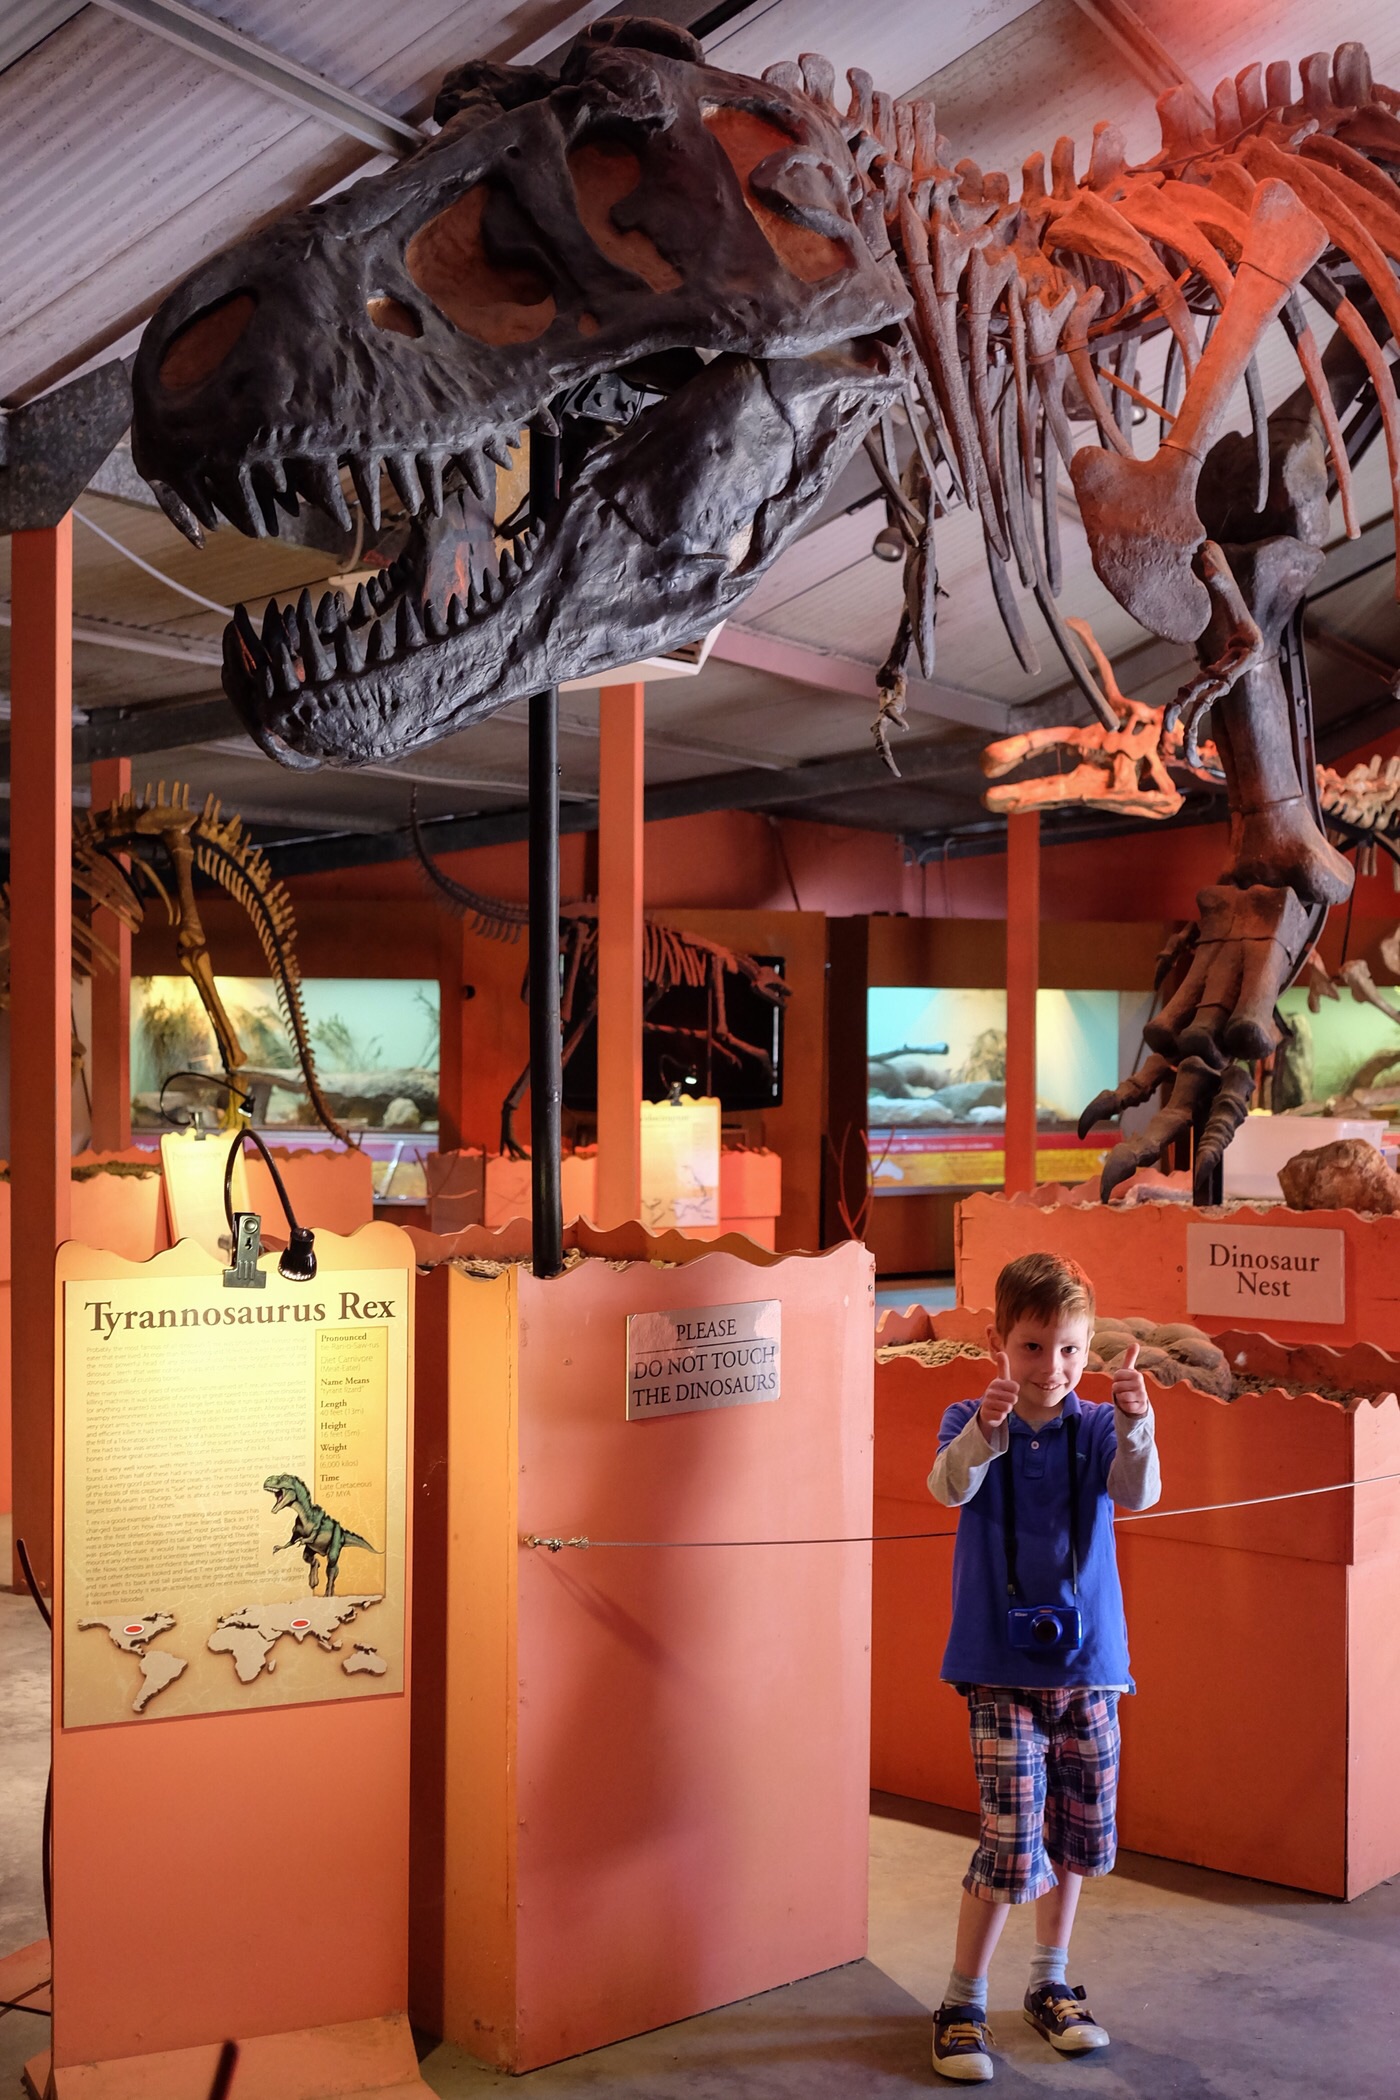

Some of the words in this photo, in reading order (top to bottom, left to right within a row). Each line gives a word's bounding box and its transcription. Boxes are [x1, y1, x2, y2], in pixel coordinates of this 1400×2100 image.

[1209, 1243, 1320, 1272] Dinosaur
[1236, 1270, 1292, 1297] Nest
[84, 1300, 326, 1340] Tyrannosaurus
[338, 1291, 396, 1320] Rex
[676, 1318, 737, 1342] PLEASE
[321, 1332, 367, 1342] Pronounced
[320, 1356, 336, 1364] Diet
[338, 1354, 374, 1363] Carnivore
[634, 1359, 663, 1380] DO
[667, 1353, 708, 1376] NOT
[711, 1345, 776, 1370] TOUCH
[345, 1376, 370, 1385] Means
[632, 1386, 671, 1407] THE
[676, 1372, 776, 1402] DINOSAURS
[320, 1399, 347, 1409] Length
[320, 1421, 347, 1431] Height
[320, 1443, 348, 1453] Weight
[336, 1481, 372, 1490] Cretaceous
